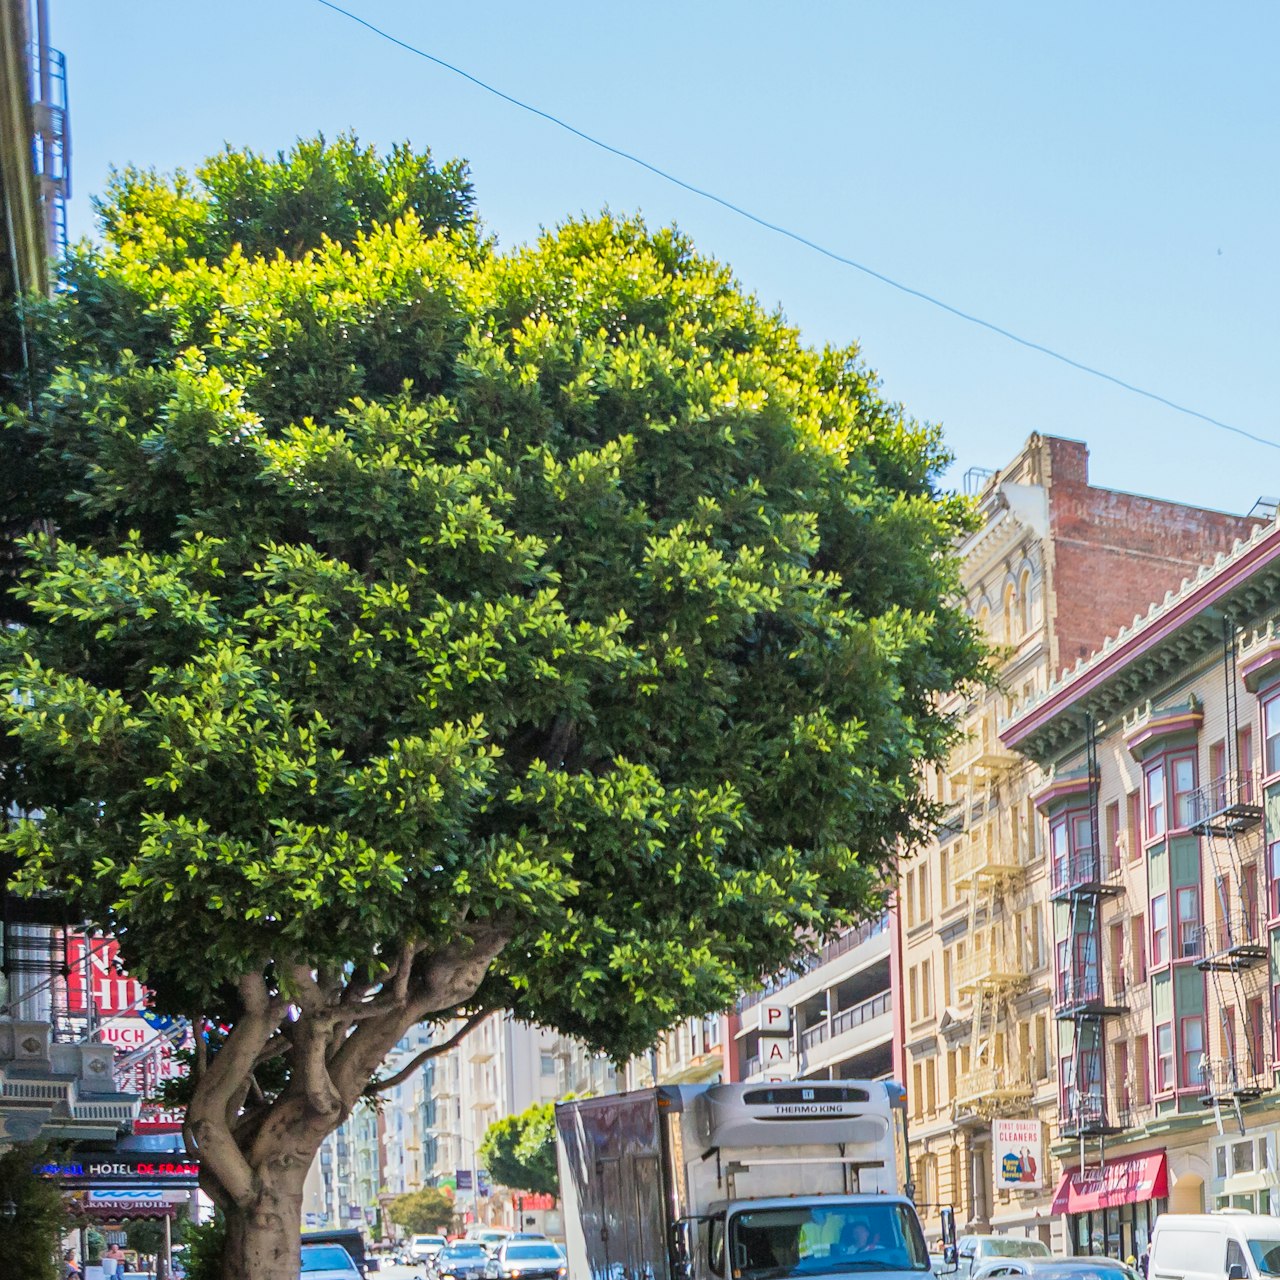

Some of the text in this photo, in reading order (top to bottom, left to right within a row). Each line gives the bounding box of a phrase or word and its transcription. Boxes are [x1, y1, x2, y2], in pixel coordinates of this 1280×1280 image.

[80, 979, 152, 1011] HIL
[768, 1008, 783, 1083] PA
[776, 1105, 843, 1114] THERMO KING
[1000, 1133, 1037, 1142] CLEANERS
[137, 1164, 154, 1174] DE
[159, 1163, 199, 1175] FRAN
